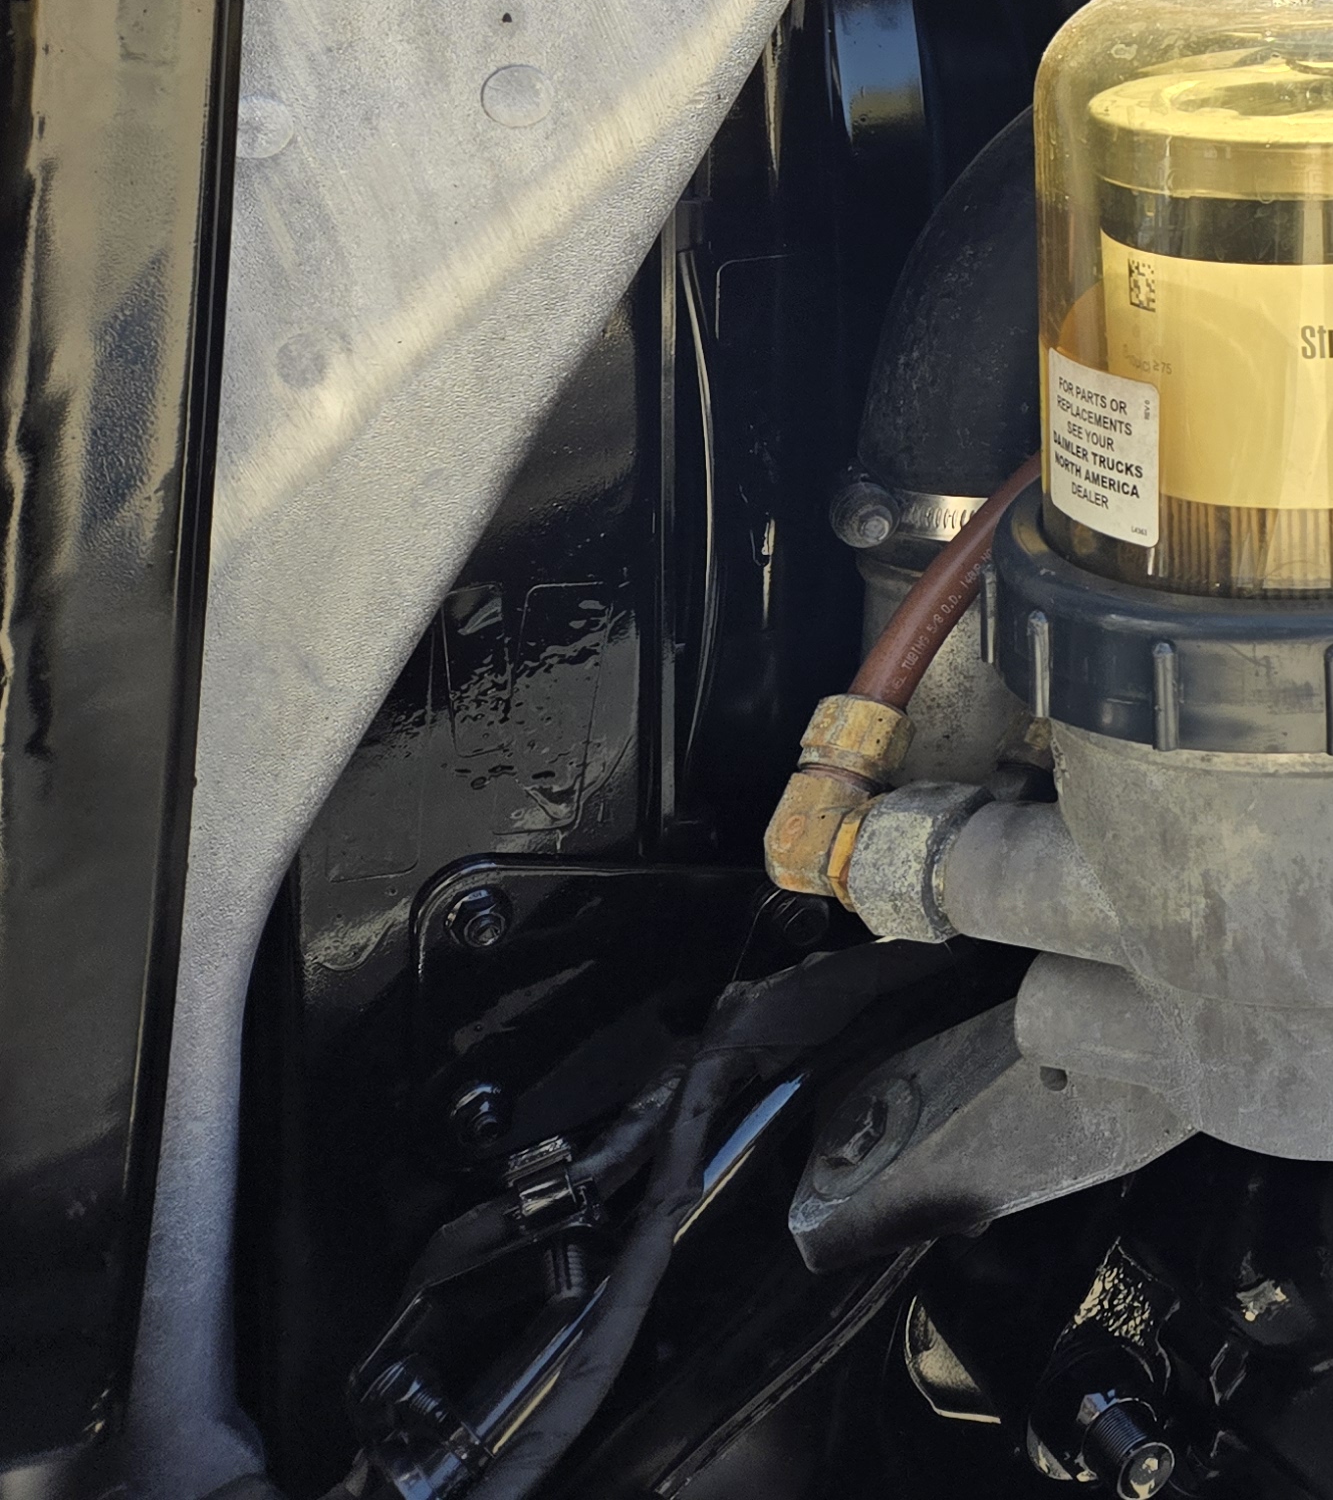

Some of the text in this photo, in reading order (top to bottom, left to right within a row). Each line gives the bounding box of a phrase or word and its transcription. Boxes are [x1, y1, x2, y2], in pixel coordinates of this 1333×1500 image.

[1057, 395, 1132, 436] REPLACEMENTS
[1059, 377, 1128, 415] FOR PARTS OR
[1053, 430, 1143, 479] DAIMLER TRUCKS
[1067, 421, 1114, 452] SEE YOUR
[1055, 451, 1140, 499] NORTH AMERICA
[1072, 482, 1109, 510] DEALER
[901, 635, 930, 671] TUBING
[927, 614, 943, 633] 5/8
